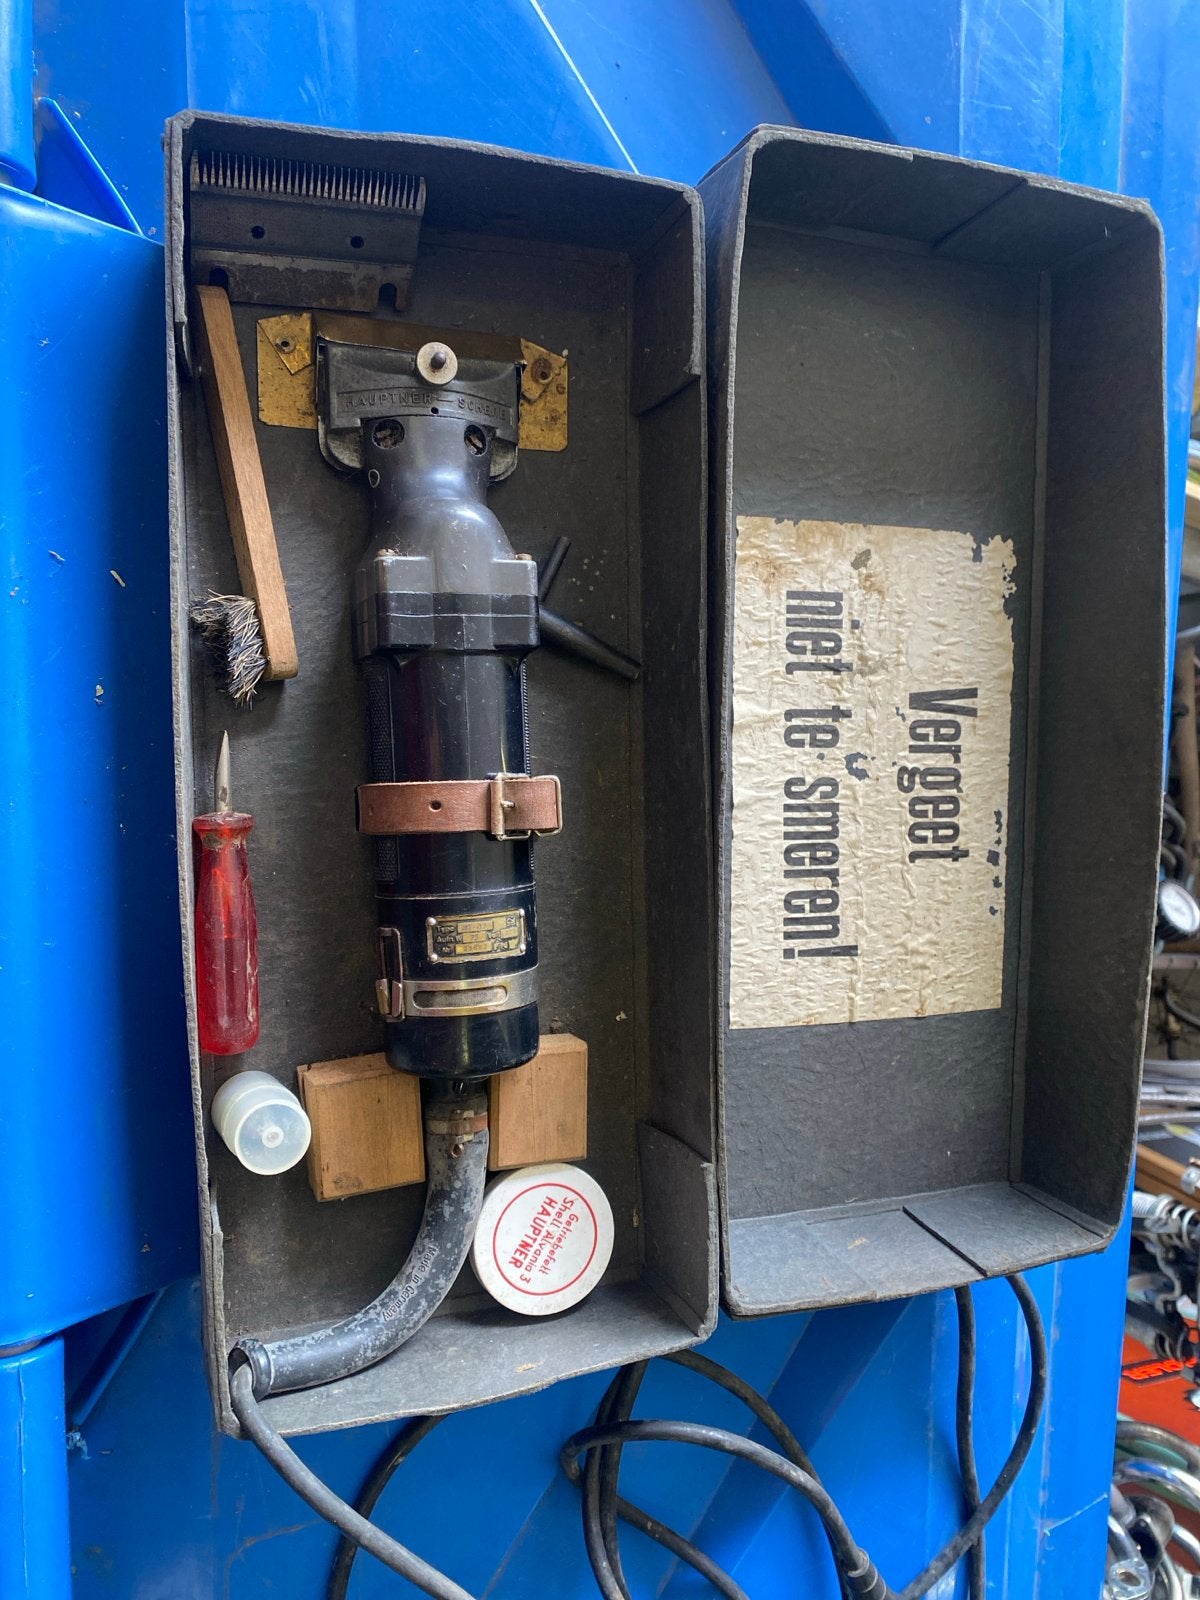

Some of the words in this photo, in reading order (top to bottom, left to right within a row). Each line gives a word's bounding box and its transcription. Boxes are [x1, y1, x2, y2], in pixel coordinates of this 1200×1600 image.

[344, 391, 433, 408] HAUPTNER
[785, 590, 860, 676] niet
[784, 705, 852, 749] te
[897, 688, 978, 864] Vergeet
[783, 776, 859, 959] smeren!
[508, 1195, 558, 1269] HAUPTNER
[550, 1196, 574, 1229] Shell
[419, 1244, 437, 1272] Made
[525, 1230, 554, 1272] Alvania
[539, 1213, 579, 1275] Getriebefett
[412, 1274, 422, 1284] in
[520, 1274, 532, 1284] 3
[382, 1285, 415, 1322] Germany
